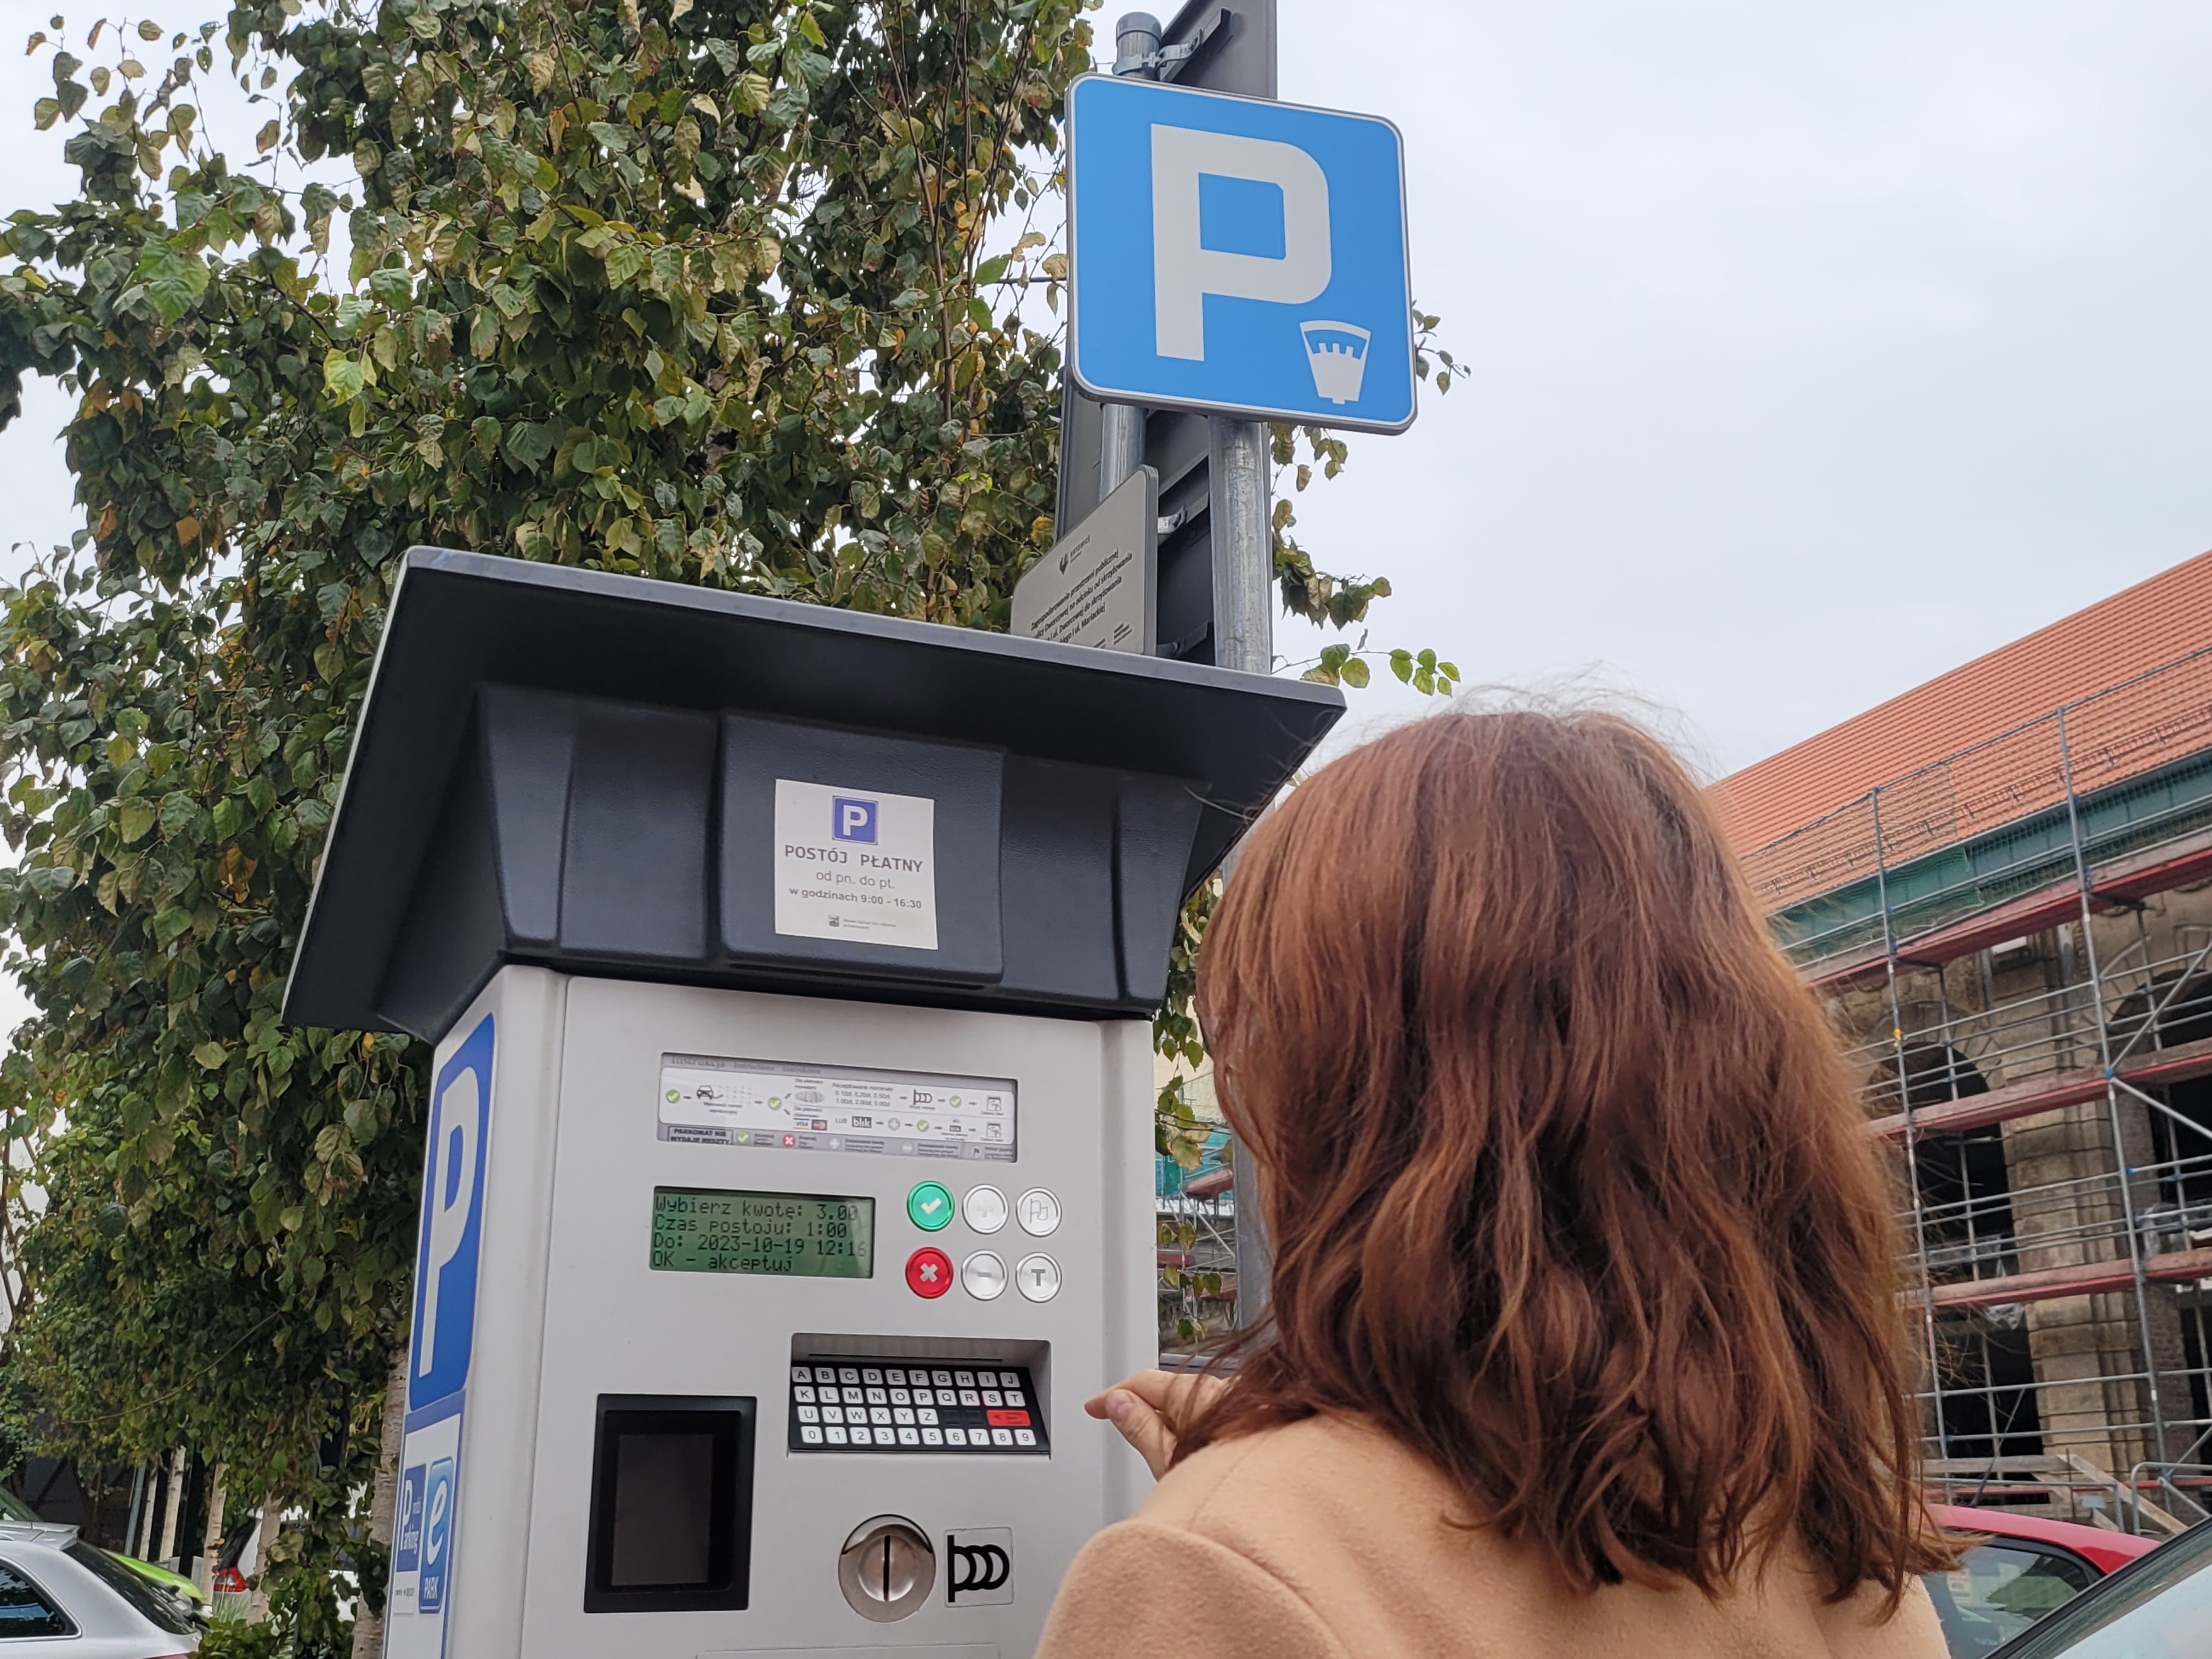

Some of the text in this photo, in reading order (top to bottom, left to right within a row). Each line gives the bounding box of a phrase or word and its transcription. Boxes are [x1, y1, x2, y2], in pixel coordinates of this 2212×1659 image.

[1150, 123, 1333, 362] P
[843, 805, 868, 836] P
[785, 844, 923, 872] POSTÓJ PŁATNY
[816, 870, 895, 890] od pn. do pt.
[802, 888, 857, 902] godzinach
[861, 895, 883, 904] 9:00
[894, 898, 922, 909] 16:30
[854, 1117, 871, 1127] blik
[656, 1196, 858, 1221] Wybierz kwotę: 3.00
[419, 1066, 480, 1379] P
[654, 1214, 847, 1238] Czas postoju: 1:00
[653, 1233, 867, 1257] Do: 2023-10-19 12:16
[653, 1251, 675, 1267] OK
[708, 1254, 792, 1272] akceptuj
[1031, 1268, 1046, 1286] T
[798, 1370, 806, 1379] A
[821, 1371, 830, 1379] B
[845, 1372, 854, 1380] C
[868, 1372, 877, 1380] D
[892, 1373, 900, 1381] E
[825, 1391, 833, 1399] L
[872, 1392, 881, 1400] N
[895, 1392, 905, 1401] O
[942, 1393, 951, 1401] Q
[989, 1394, 997, 1402] S
[804, 1410, 813, 1418] U
[809, 1431, 816, 1439] 0
[857, 1431, 865, 1440] 2
[881, 1432, 889, 1440] 3
[929, 1432, 936, 1441] 5
[953, 1432, 960, 1441] 6
[1000, 1433, 1006, 1441] 8
[1022, 1433, 1029, 1441] 9
[427, 1480, 447, 1566] e
[424, 1576, 439, 1599] PARK
